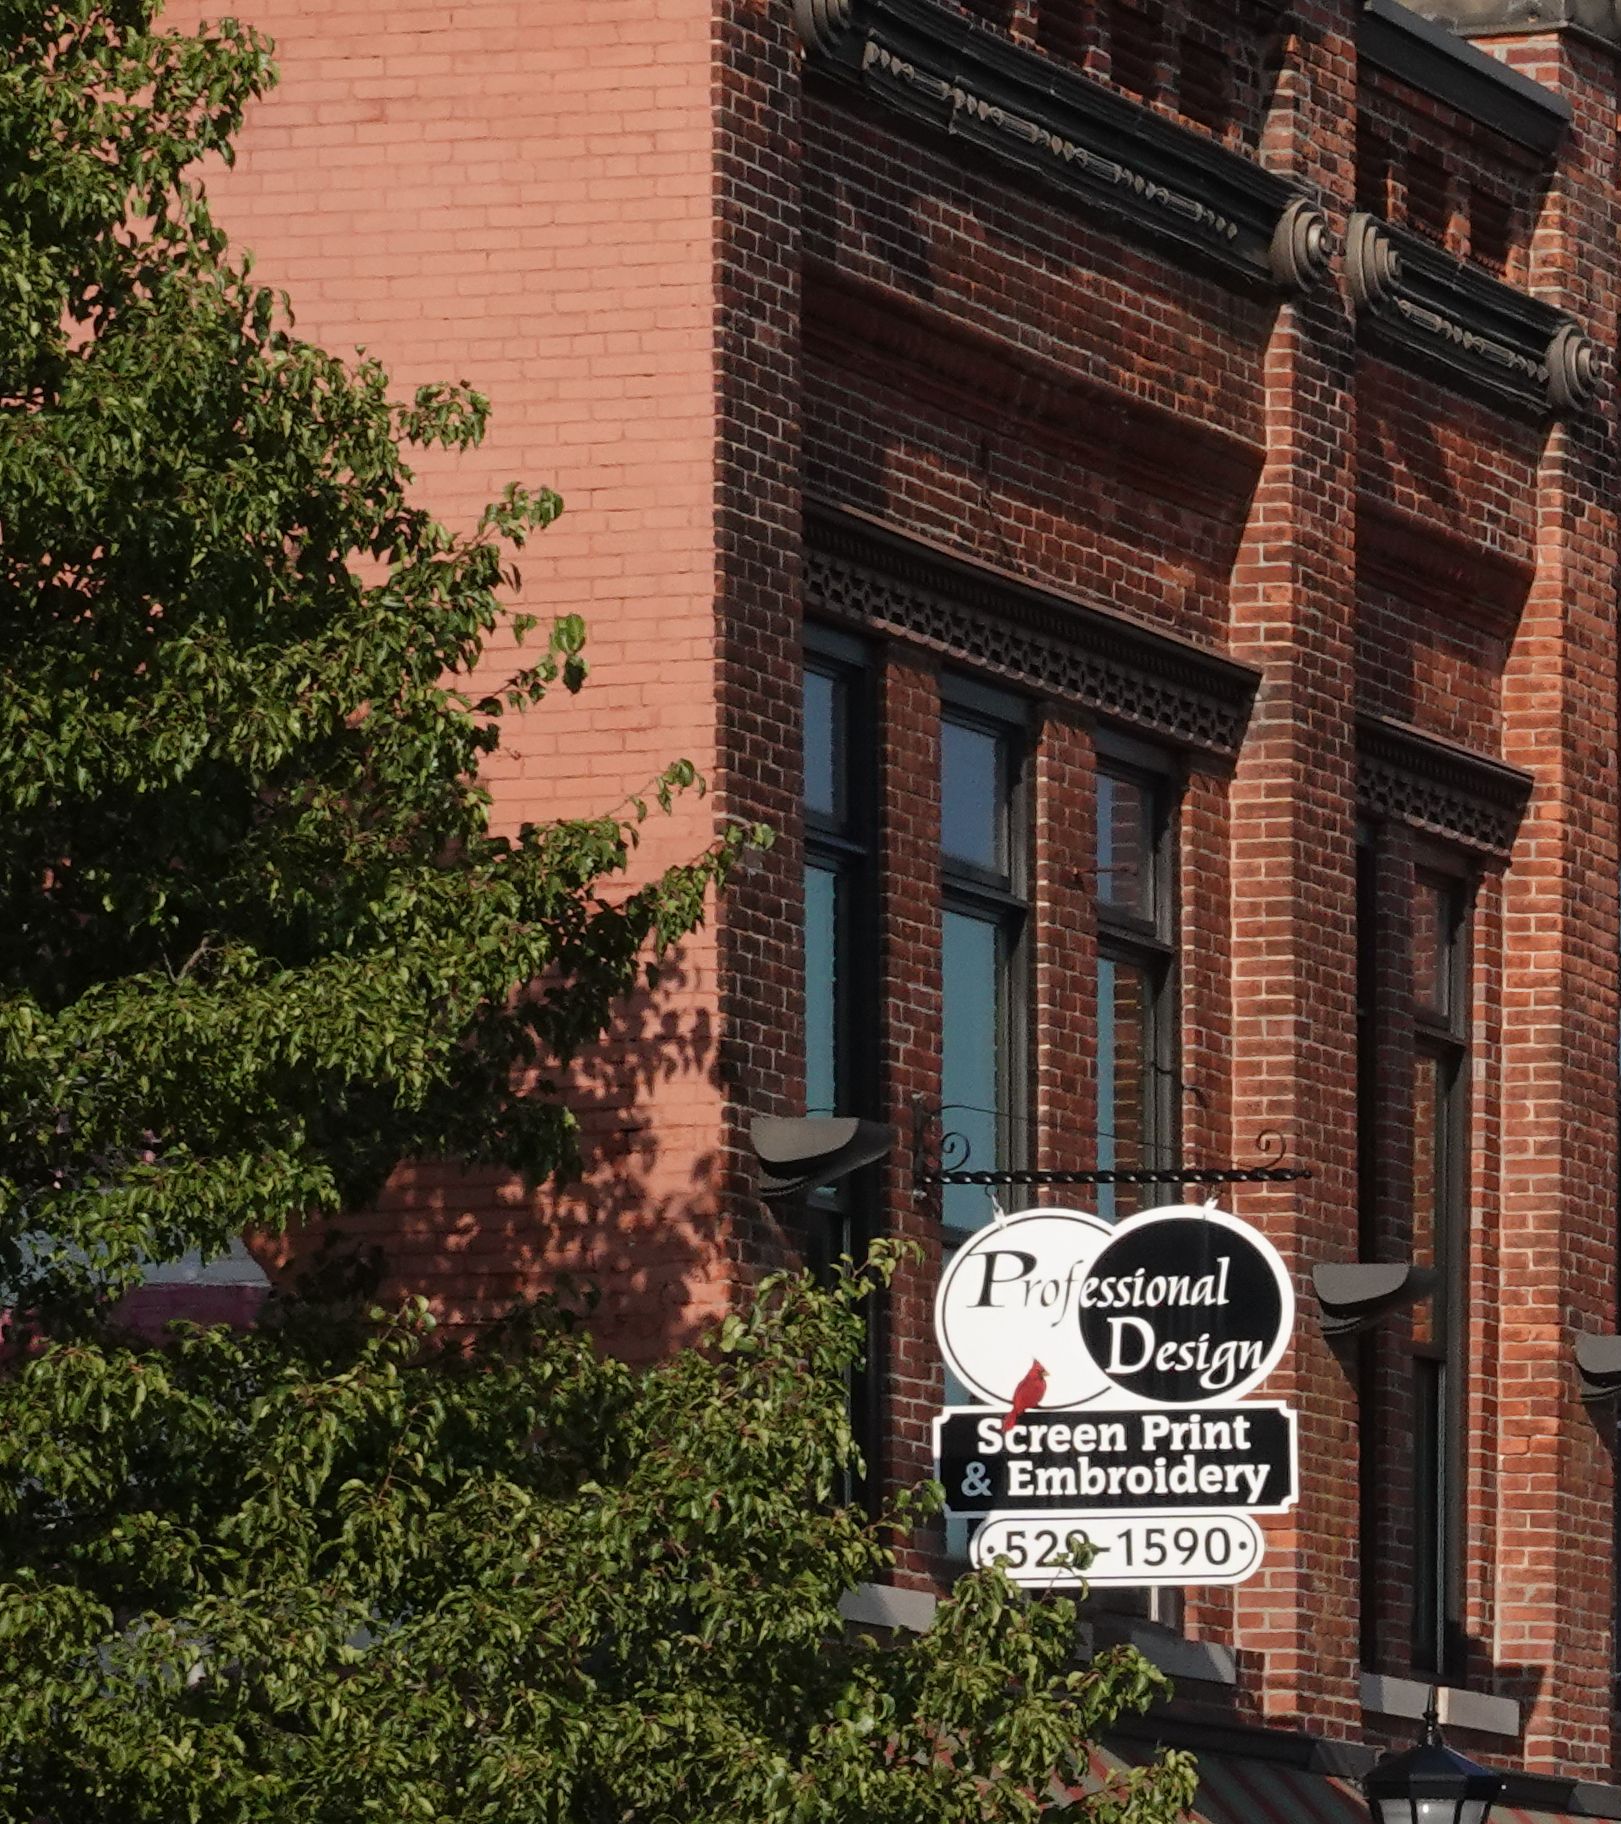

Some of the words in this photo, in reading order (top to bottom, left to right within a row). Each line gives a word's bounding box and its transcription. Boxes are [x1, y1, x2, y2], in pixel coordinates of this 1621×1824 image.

[965, 1248, 1230, 1328] Professional
[1105, 1315, 1264, 1390] Design
[977, 1415, 1128, 1455] Screen
[1141, 1414, 1251, 1451] Print
[960, 1461, 992, 1496] &
[1008, 1454, 1271, 1504] Embroidery
